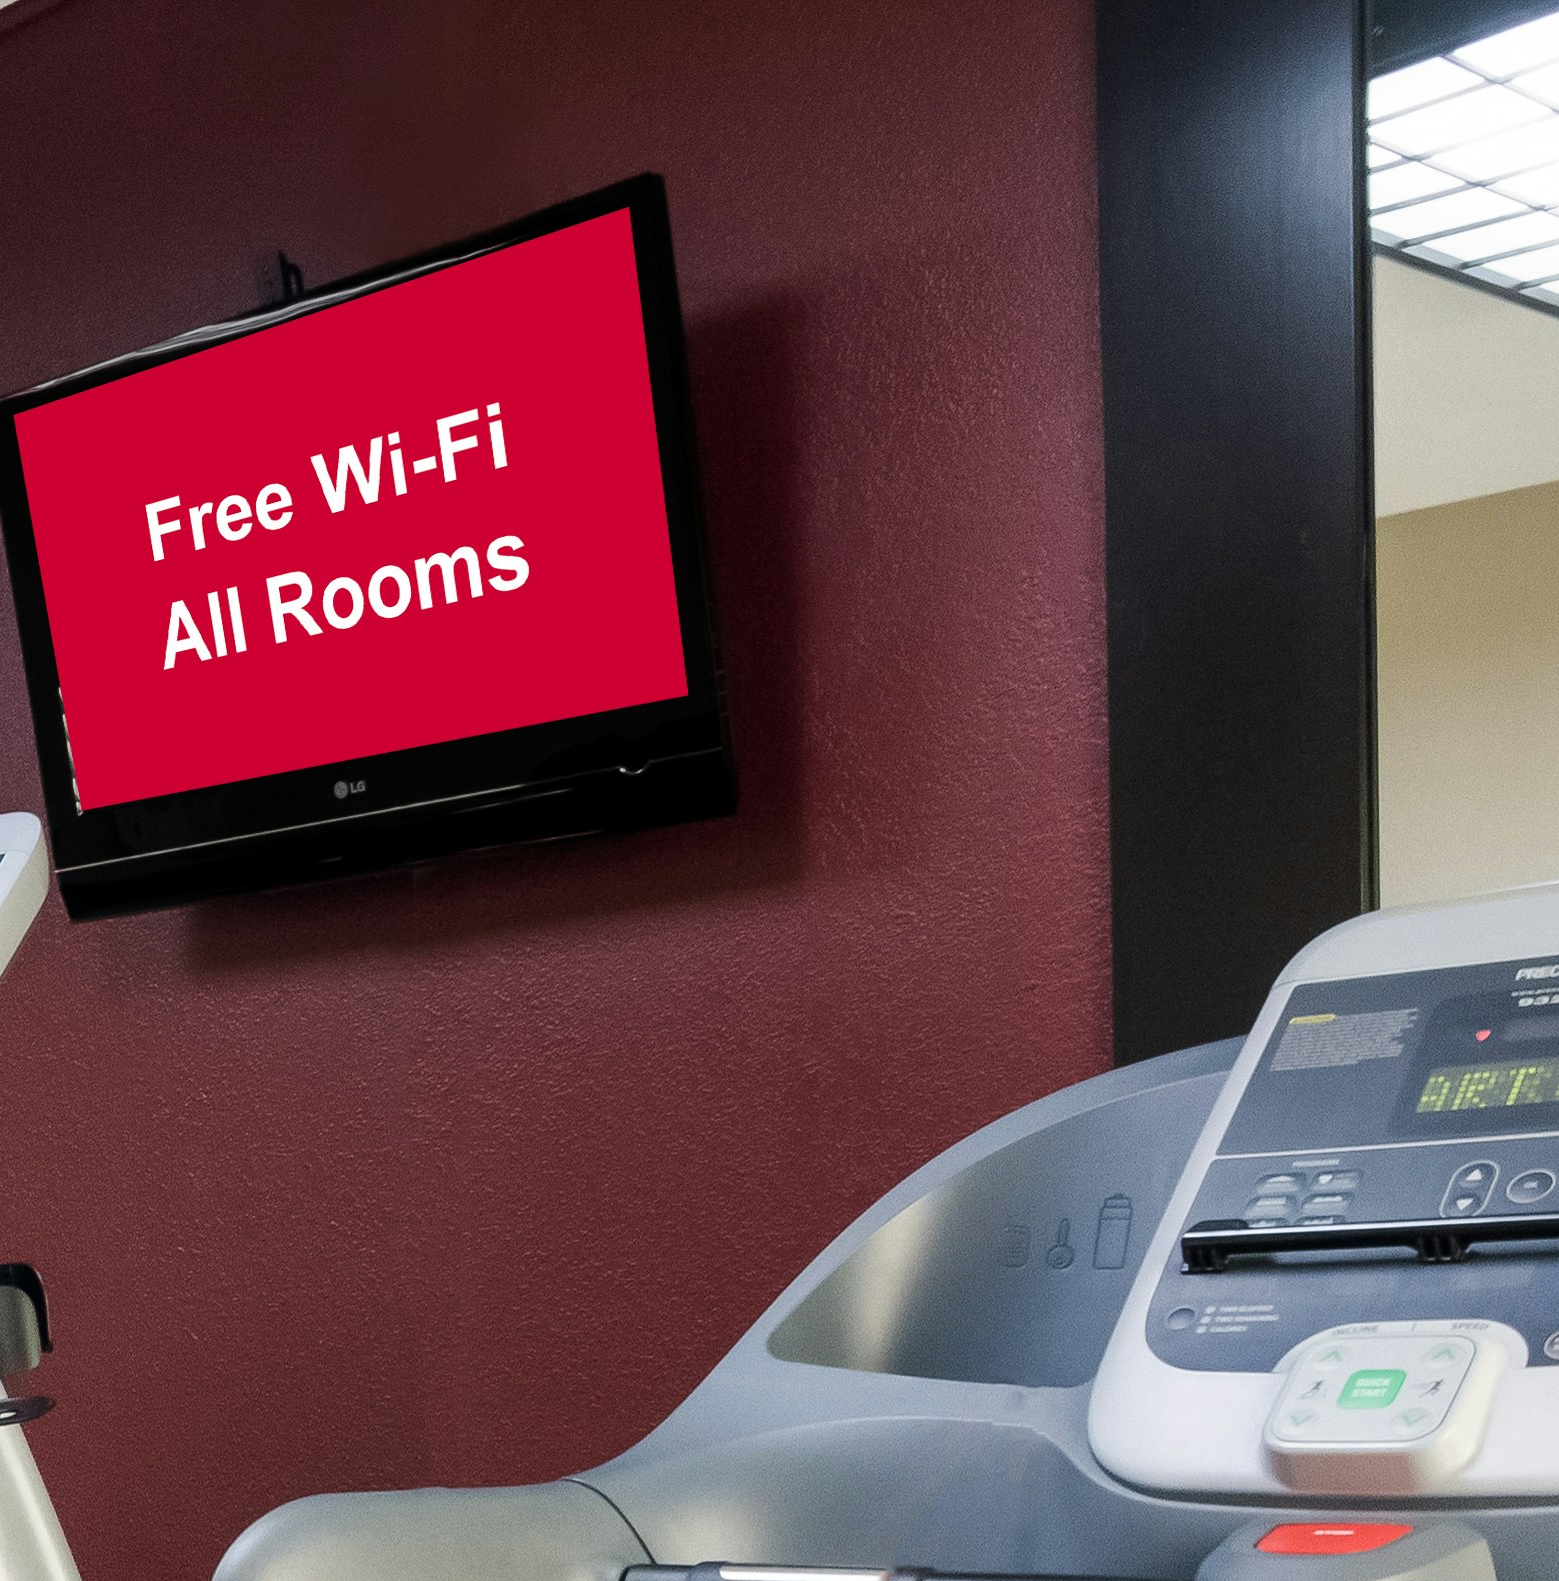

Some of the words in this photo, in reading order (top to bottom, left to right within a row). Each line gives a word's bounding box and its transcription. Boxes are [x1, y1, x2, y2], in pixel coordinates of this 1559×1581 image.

[146, 484, 293, 561] Free
[311, 402, 507, 513] Wi-Fi
[164, 587, 247, 670] All
[266, 536, 530, 643] Rooms
[350, 780, 366, 793] LG
